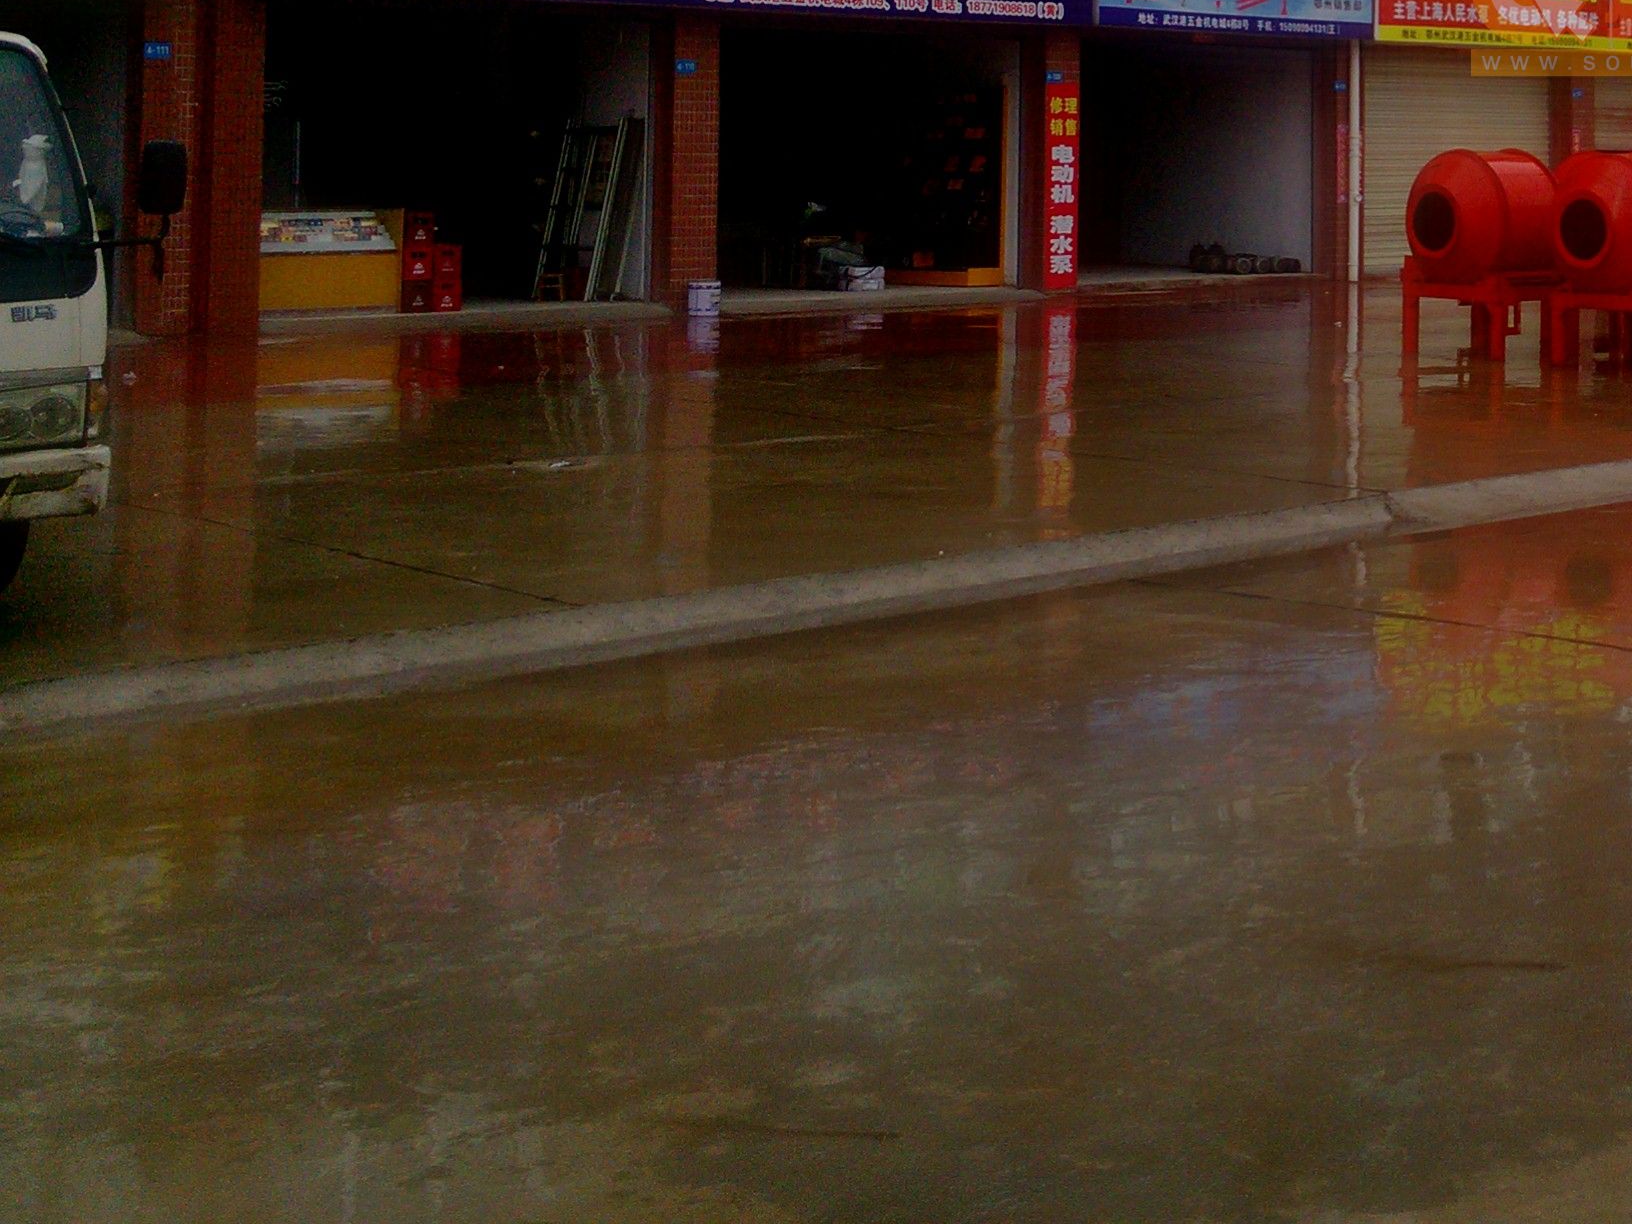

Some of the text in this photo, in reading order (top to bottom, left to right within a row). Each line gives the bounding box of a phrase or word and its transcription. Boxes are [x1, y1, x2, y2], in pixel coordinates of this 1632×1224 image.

[1050, 97, 1078, 114] 修理
[1050, 118, 1077, 136] 销售
[1050, 144, 1075, 274] 电动机 潜水泵
